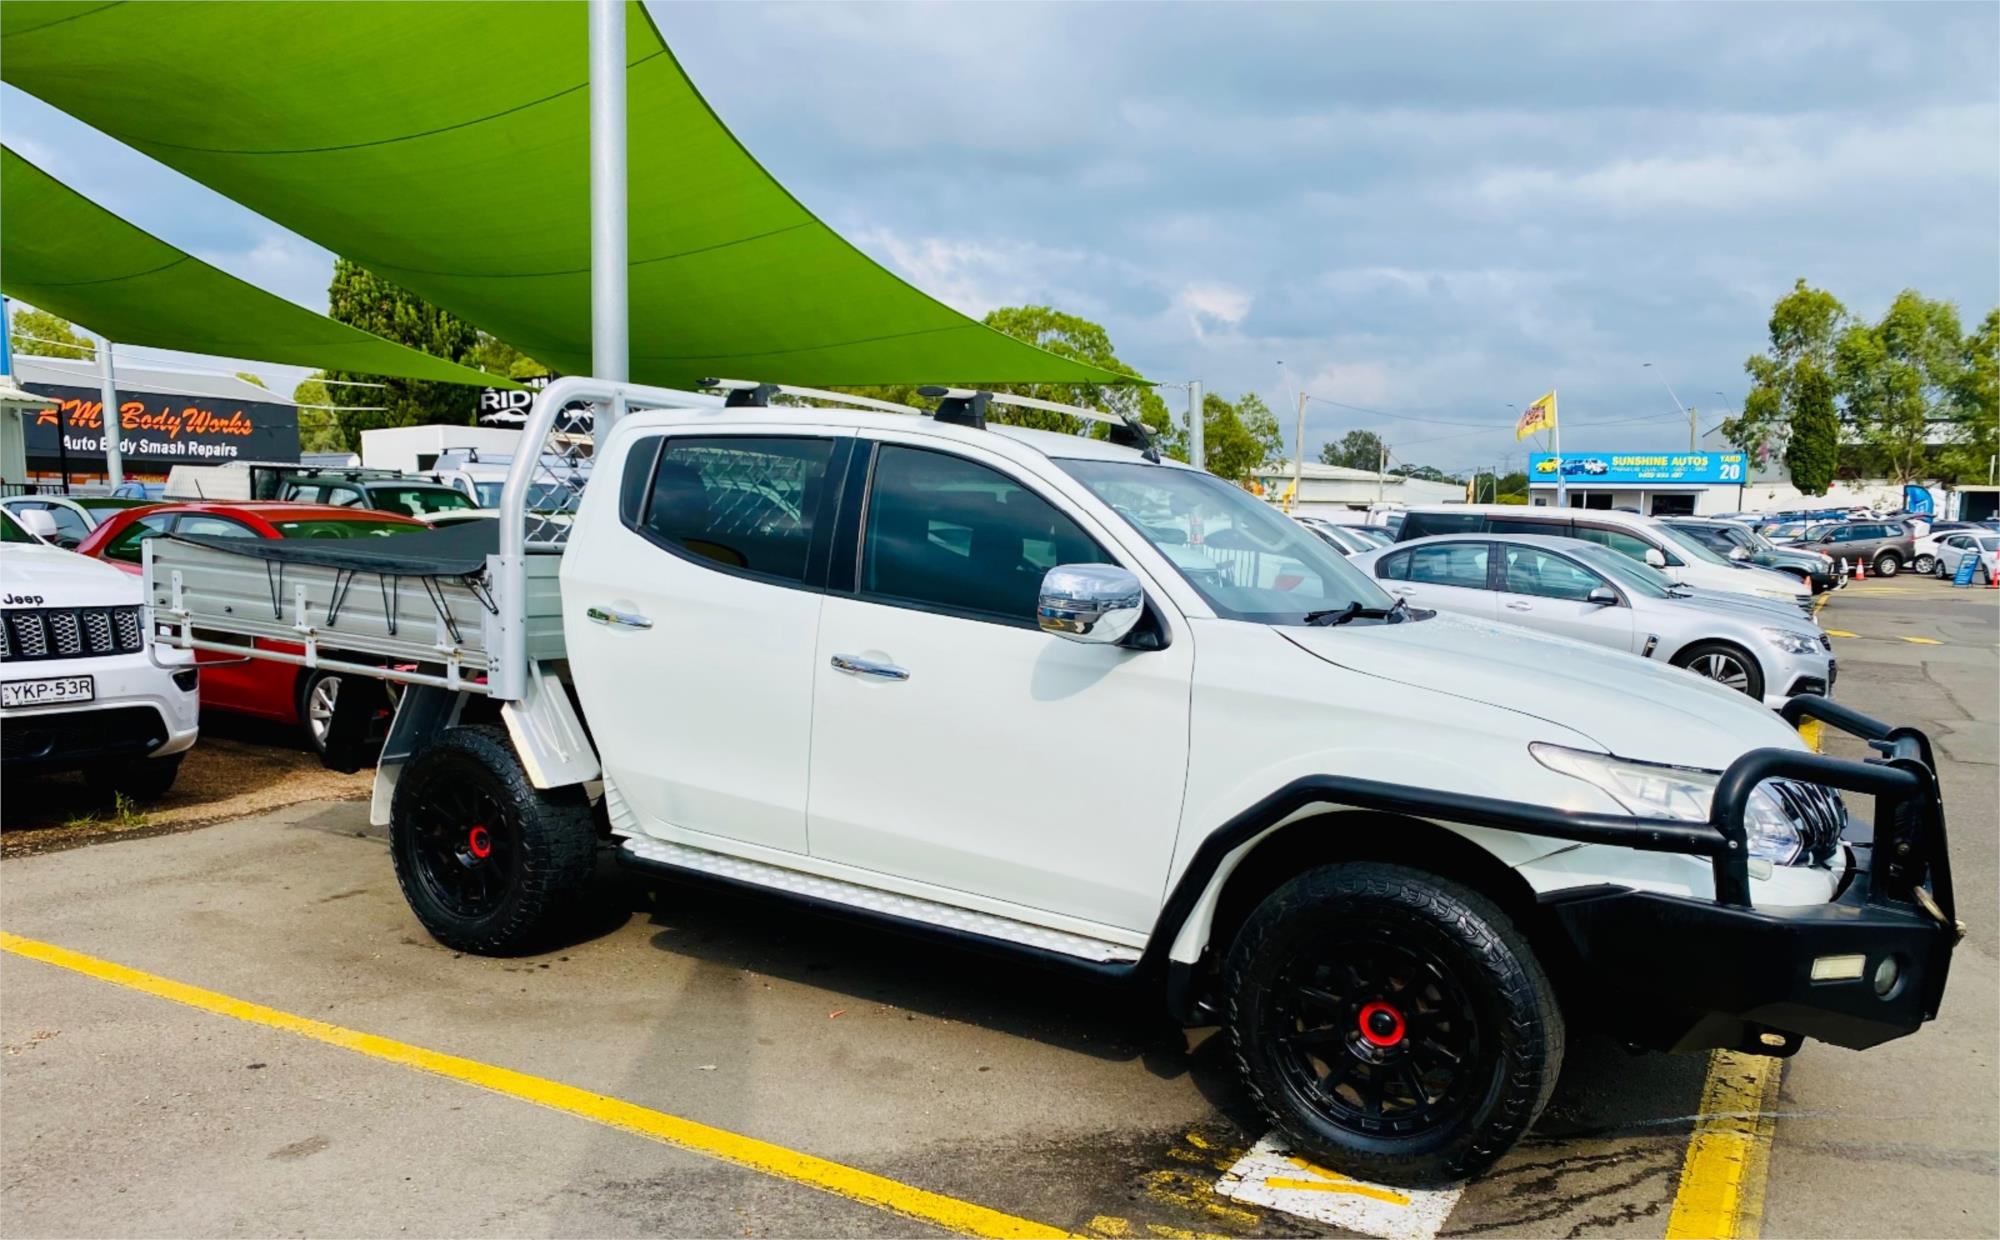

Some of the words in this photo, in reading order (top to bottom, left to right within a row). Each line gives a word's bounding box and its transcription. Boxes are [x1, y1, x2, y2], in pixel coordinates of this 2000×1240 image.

[120, 401, 182, 439] Body
[182, 408, 254, 436] Works
[63, 434, 97, 451] Auto
[99, 436, 137, 455] Bdy
[139, 438, 186, 456] Smash
[188, 440, 239, 459] Repairs
[1612, 456, 1668, 466] SUNSHINE
[1671, 456, 1709, 466] AUTOS
[1719, 464, 1741, 479] 20
[3, 593, 45, 606] Jeep
